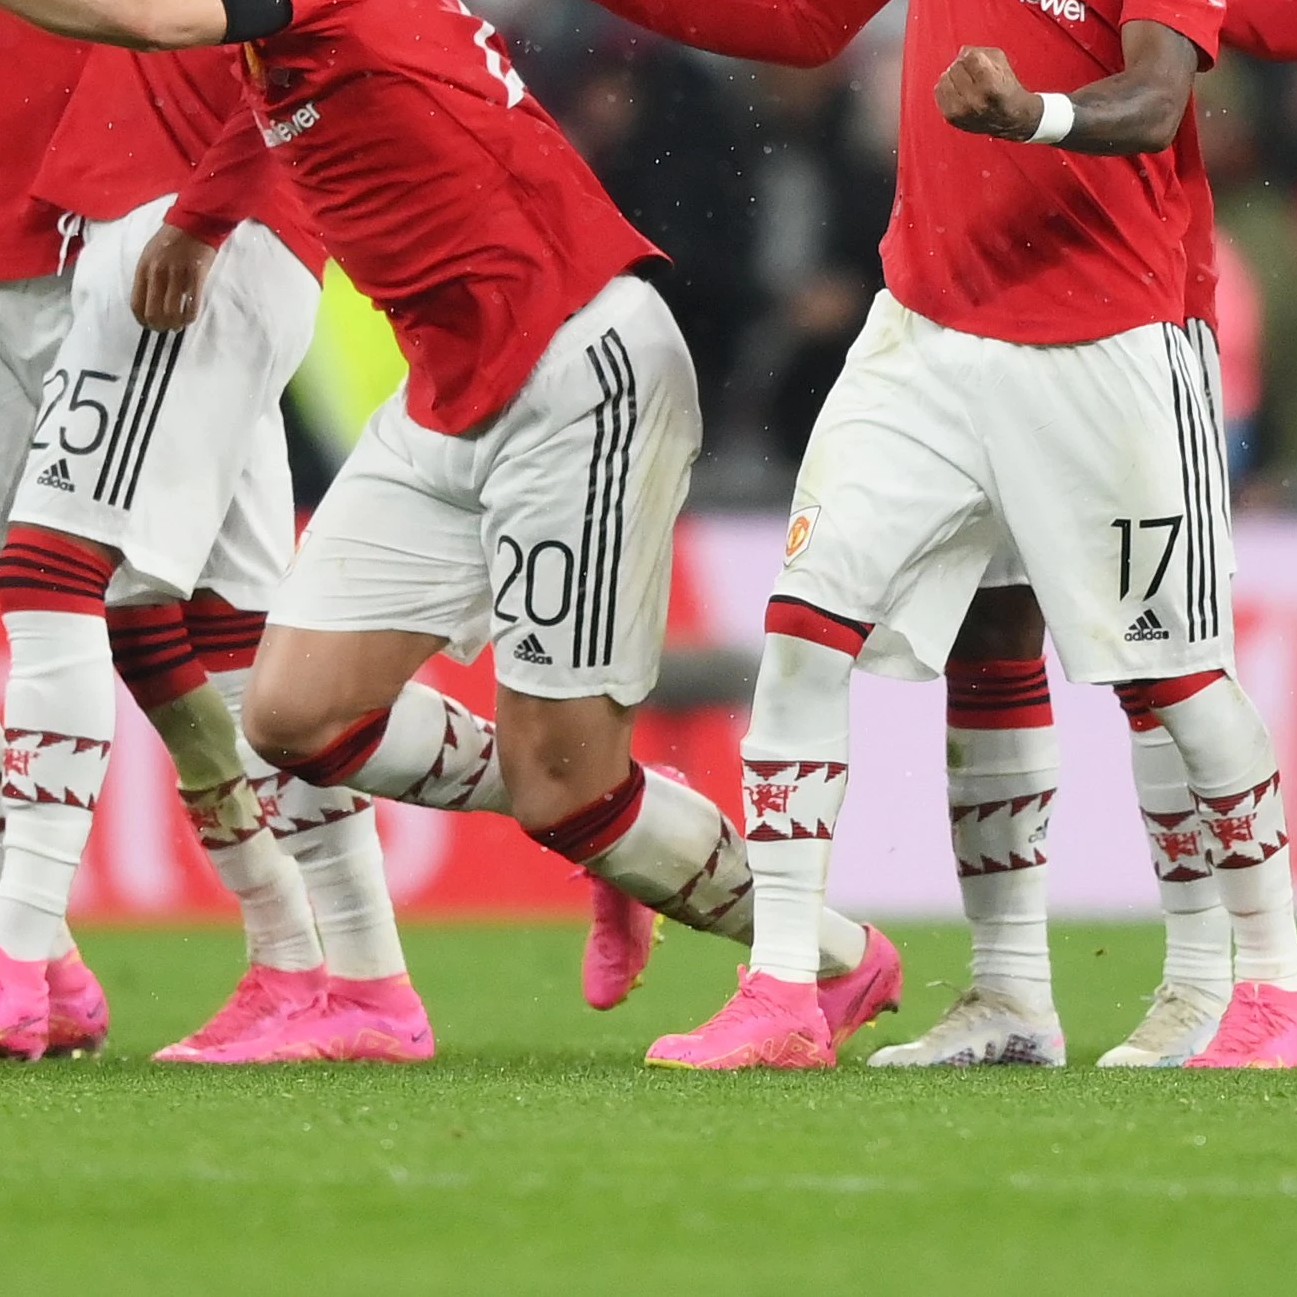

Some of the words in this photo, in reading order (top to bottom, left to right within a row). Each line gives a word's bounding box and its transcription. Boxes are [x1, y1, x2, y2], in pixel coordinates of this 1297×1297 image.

[31, 368, 120, 456] 25
[494, 534, 575, 627] 20
[1110, 514, 1184, 602] 17
[1124, 626, 1169, 642] adidas
